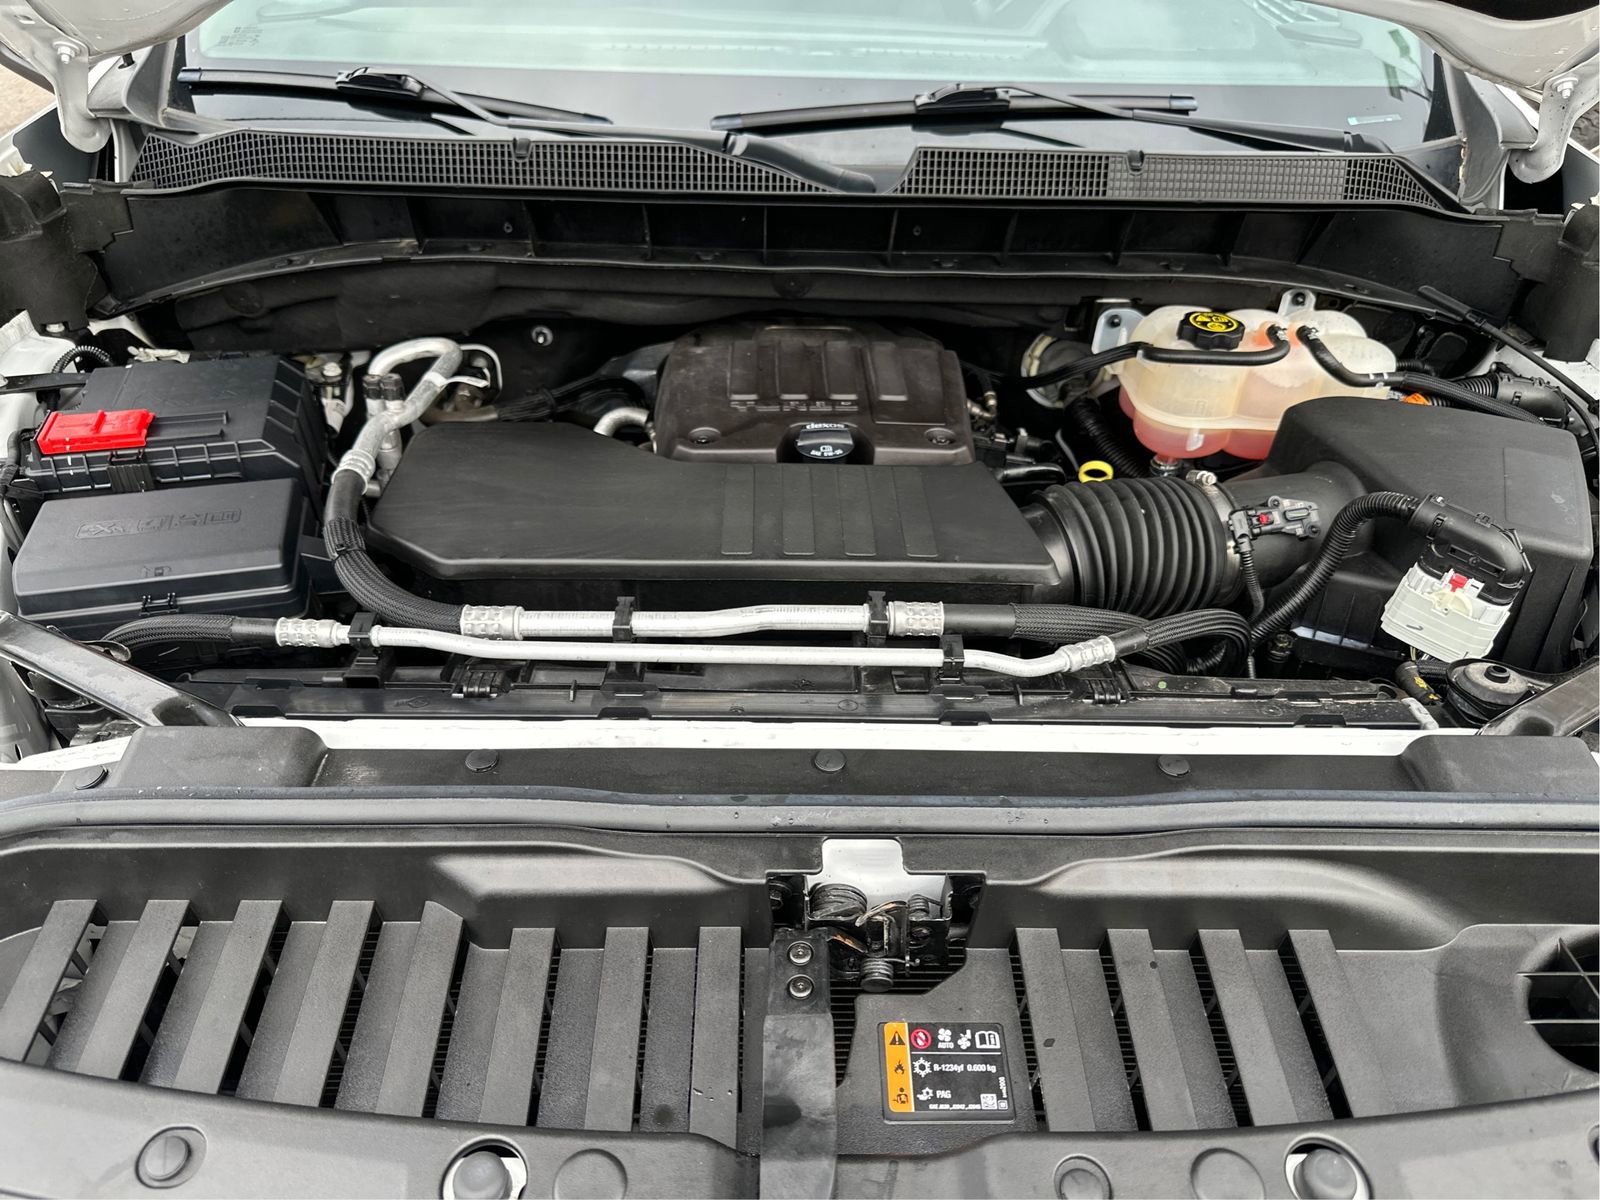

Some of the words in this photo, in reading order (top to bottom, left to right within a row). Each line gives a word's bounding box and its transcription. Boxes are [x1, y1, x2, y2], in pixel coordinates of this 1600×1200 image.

[933, 1064, 964, 1073] R-1234yf
[967, 1064, 986, 1072] 0.600
[987, 1064, 996, 1073] kg
[936, 1090, 952, 1099] PAG
